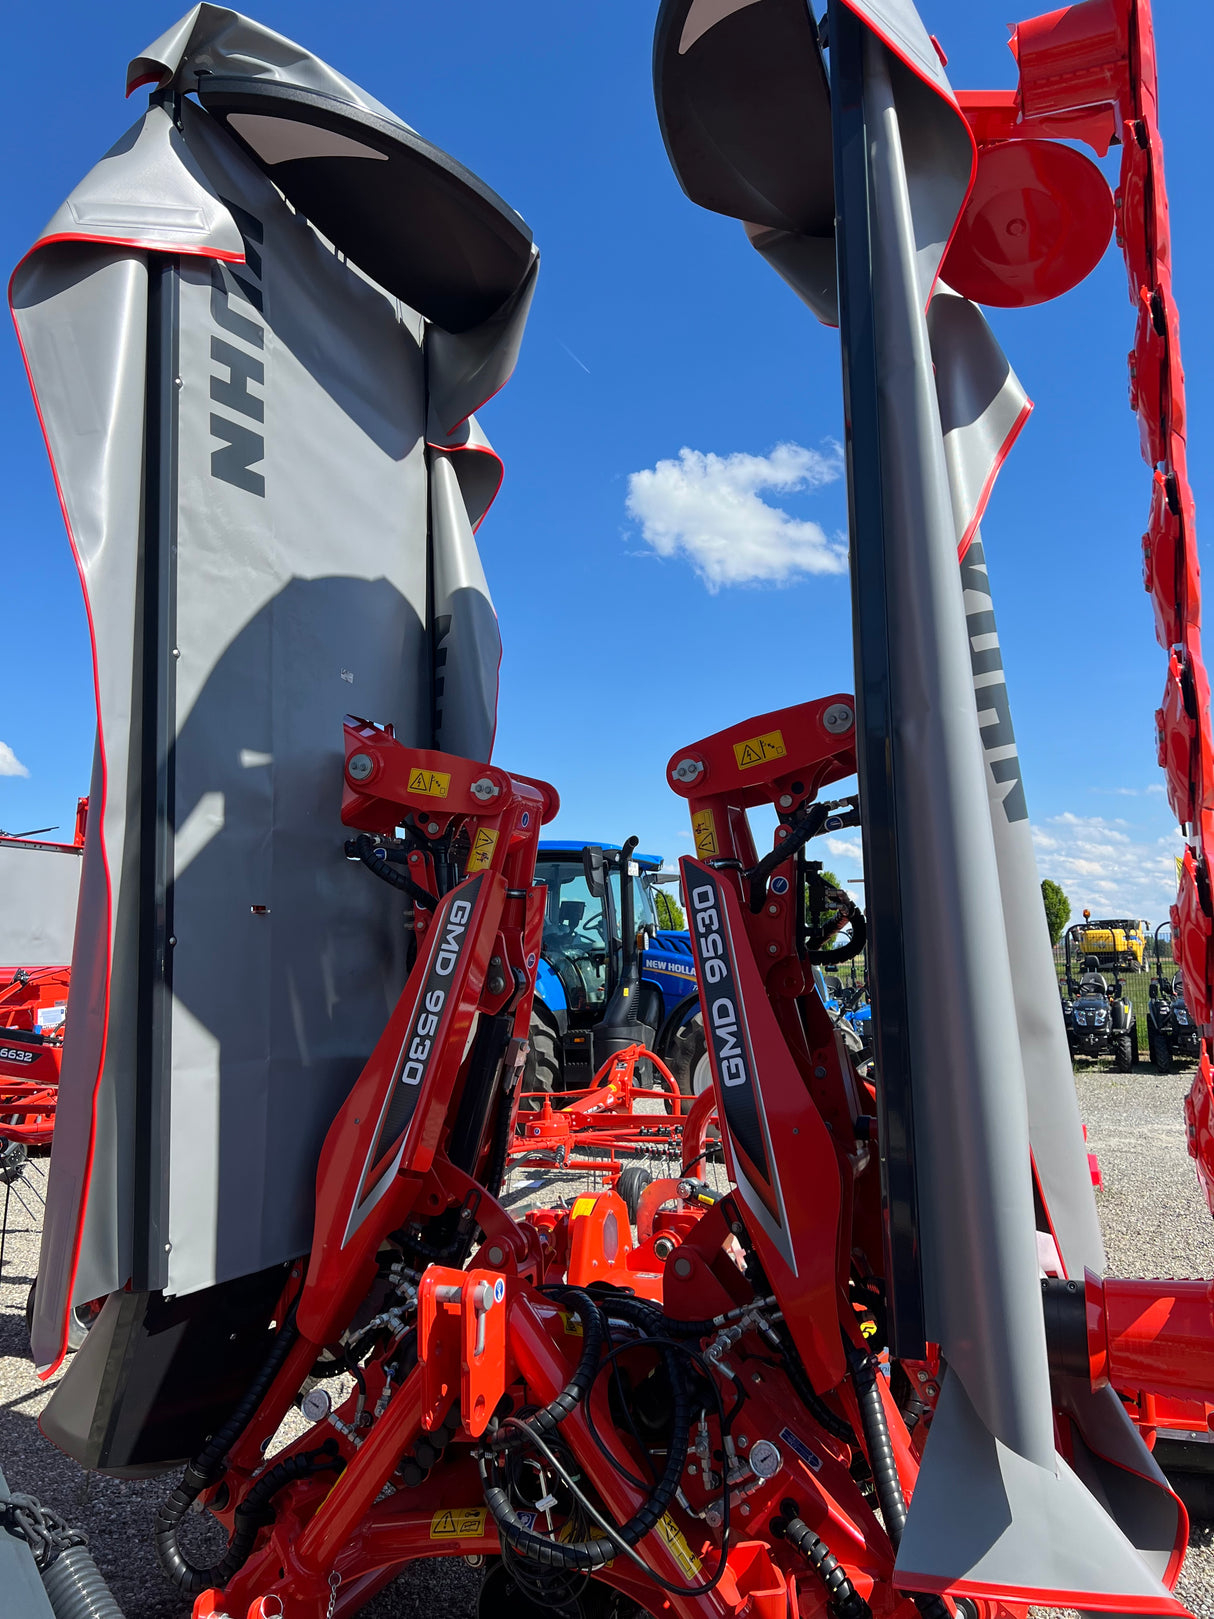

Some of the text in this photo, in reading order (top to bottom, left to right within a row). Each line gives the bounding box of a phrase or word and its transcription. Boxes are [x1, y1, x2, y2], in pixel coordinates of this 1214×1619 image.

[401, 900, 471, 1086] GMD 9530
[646, 960, 666, 969] NEW
[692, 884, 747, 1087] GMD 9530
[1, 1048, 32, 1062] 6632
